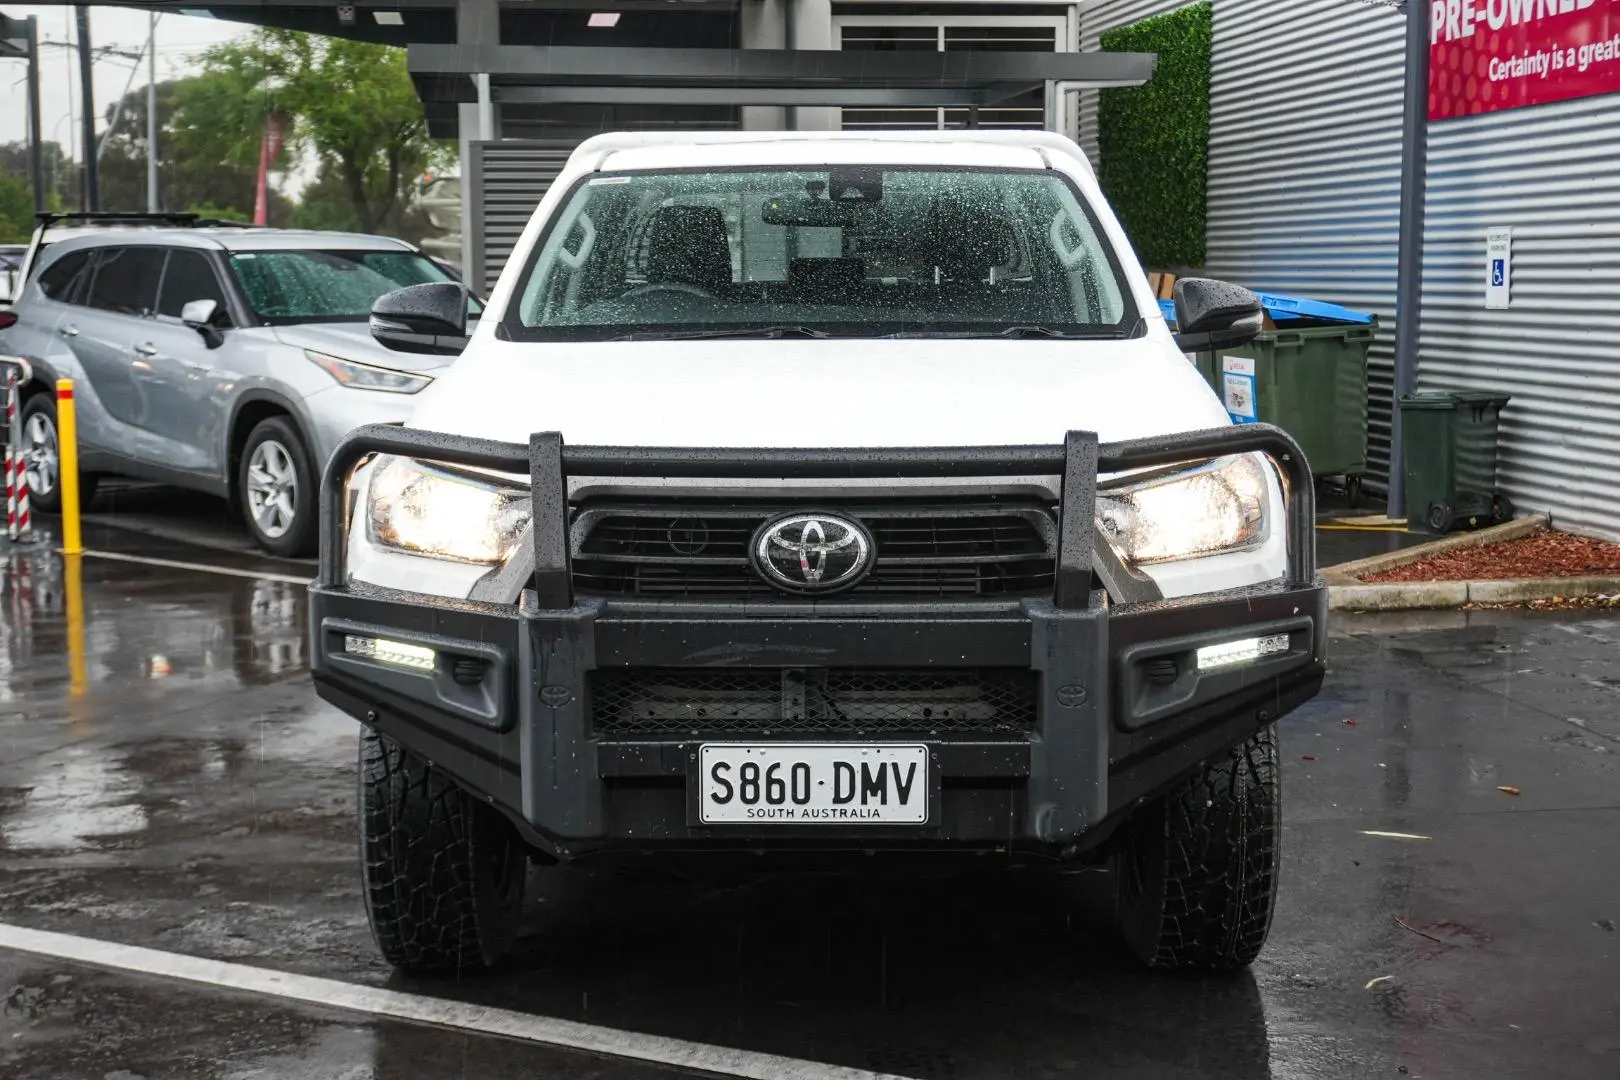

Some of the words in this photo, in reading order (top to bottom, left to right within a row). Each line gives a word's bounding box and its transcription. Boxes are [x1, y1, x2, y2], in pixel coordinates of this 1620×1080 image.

[1430, 0, 1596, 45] PRE-OW
[1489, 50, 1550, 81] Certainty
[1552, 43, 1564, 70] is
[1566, 48, 1575, 67] a
[1577, 33, 1620, 72] great
[748, 808, 795, 818] SOUTH
[802, 808, 881, 818] AUSTRALIA
